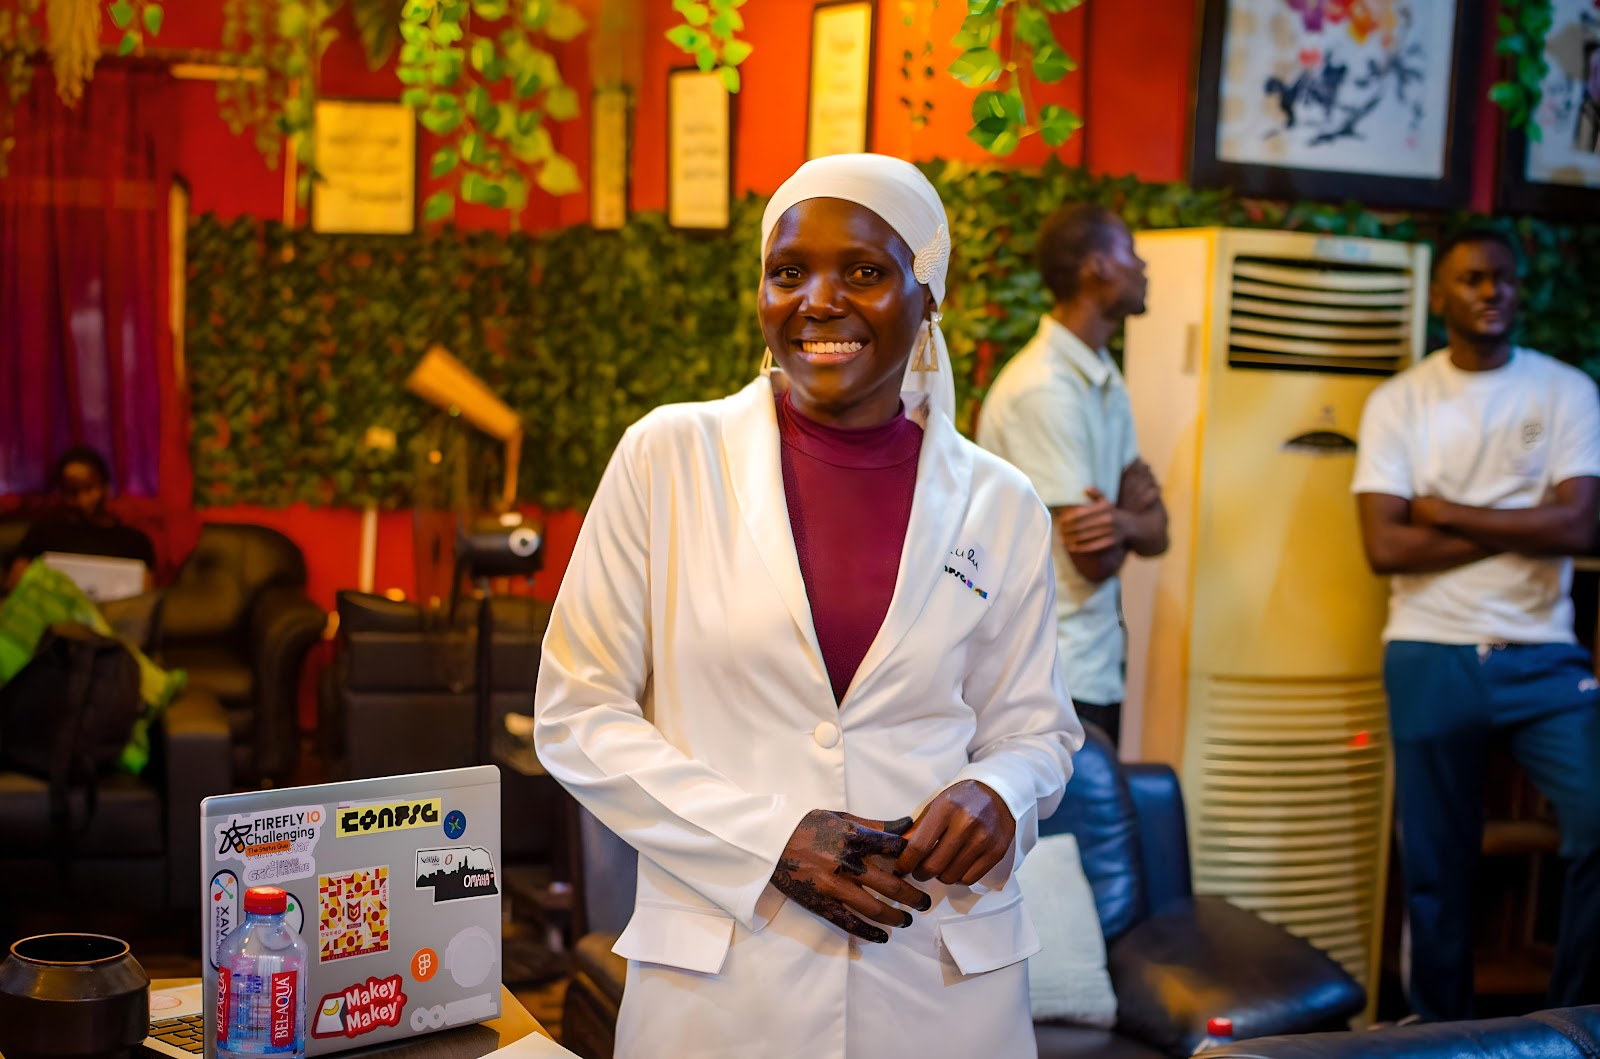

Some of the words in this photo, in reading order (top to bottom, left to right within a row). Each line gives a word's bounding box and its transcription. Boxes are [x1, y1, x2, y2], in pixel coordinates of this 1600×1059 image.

[254, 812, 305, 831] FIREFLY
[245, 827, 315, 846] Challenging
[259, 845, 276, 853] Status
[463, 872, 491, 888] OMAHA
[220, 906, 230, 943] XAV
[345, 979, 397, 1010] Makey
[346, 1001, 398, 1033] Makey
